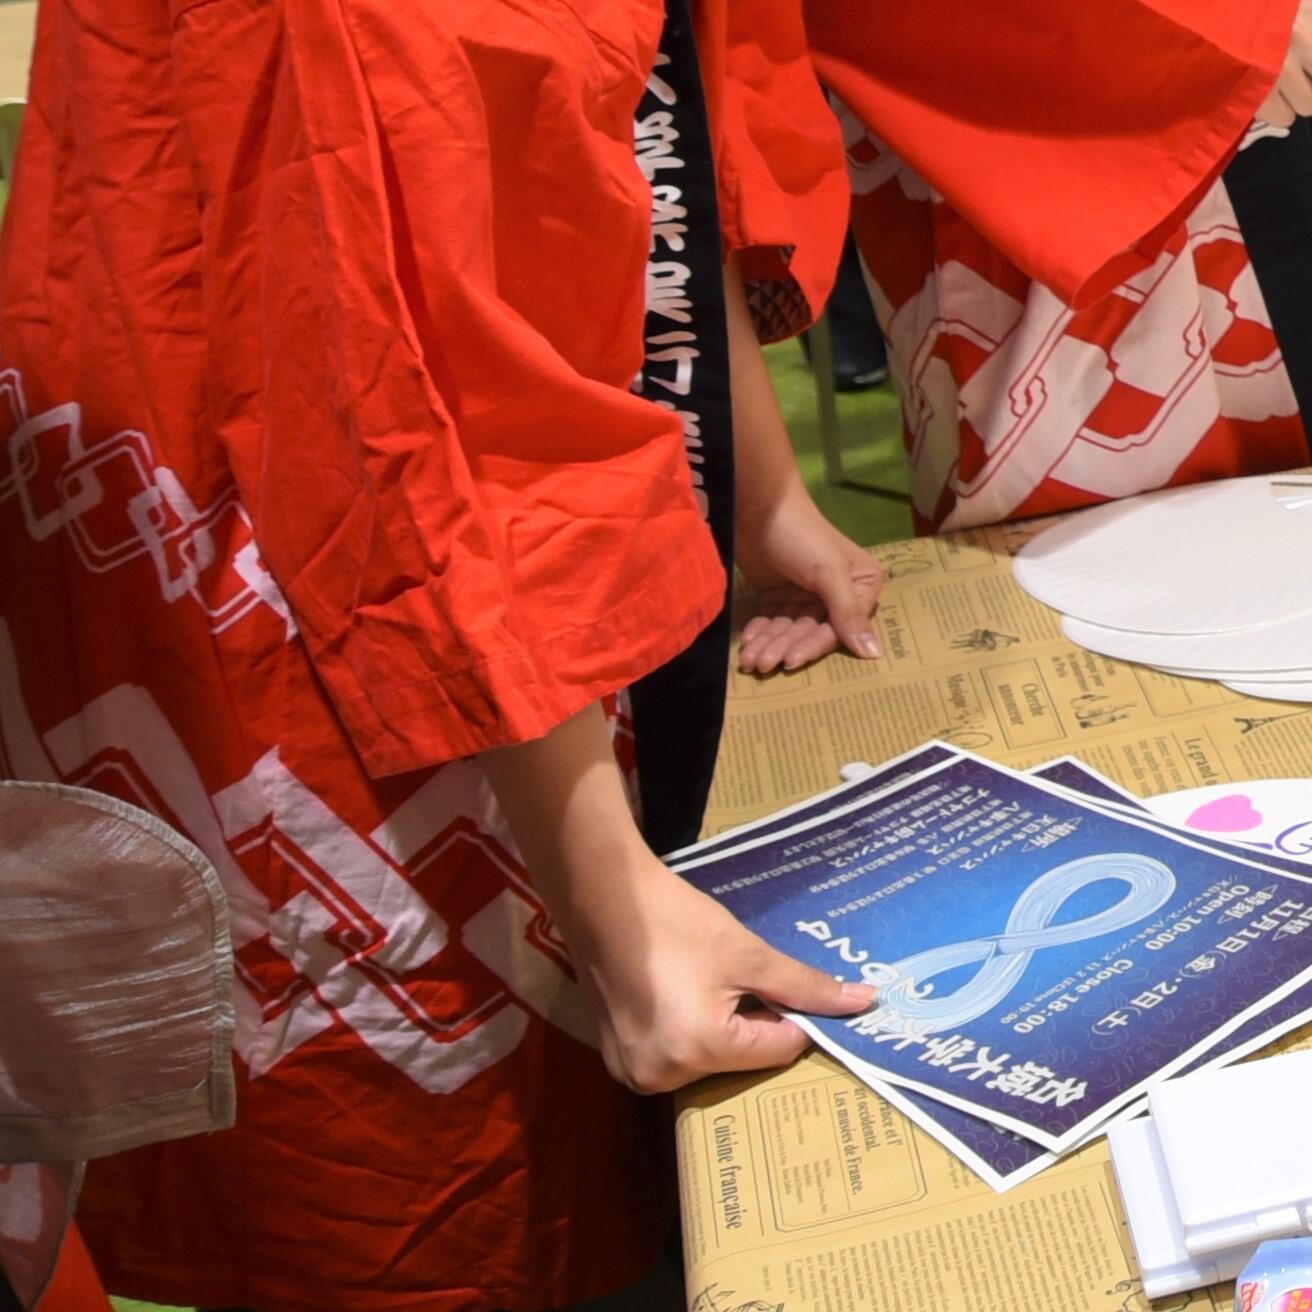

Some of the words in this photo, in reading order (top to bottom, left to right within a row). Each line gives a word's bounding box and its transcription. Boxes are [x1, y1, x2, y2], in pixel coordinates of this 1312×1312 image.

[826, 787, 993, 868] ナゴヤドーム前キャンパス
[957, 814, 1059, 870] 天白キャンパス
[1190, 882, 1254, 917] Open
[1139, 914, 1205, 951] 10:00
[788, 919, 938, 1000] 2024
[1070, 957, 1138, 995] Close
[1007, 992, 1083, 1035] 18:00
[842, 1004, 1096, 1112] 名城大学大学
[833, 1091, 849, 1108] Les
[713, 1114, 737, 1164] Cuisine
[837, 1108, 857, 1145] musées
[843, 1145, 858, 1159] de
[717, 1165, 748, 1230] française
